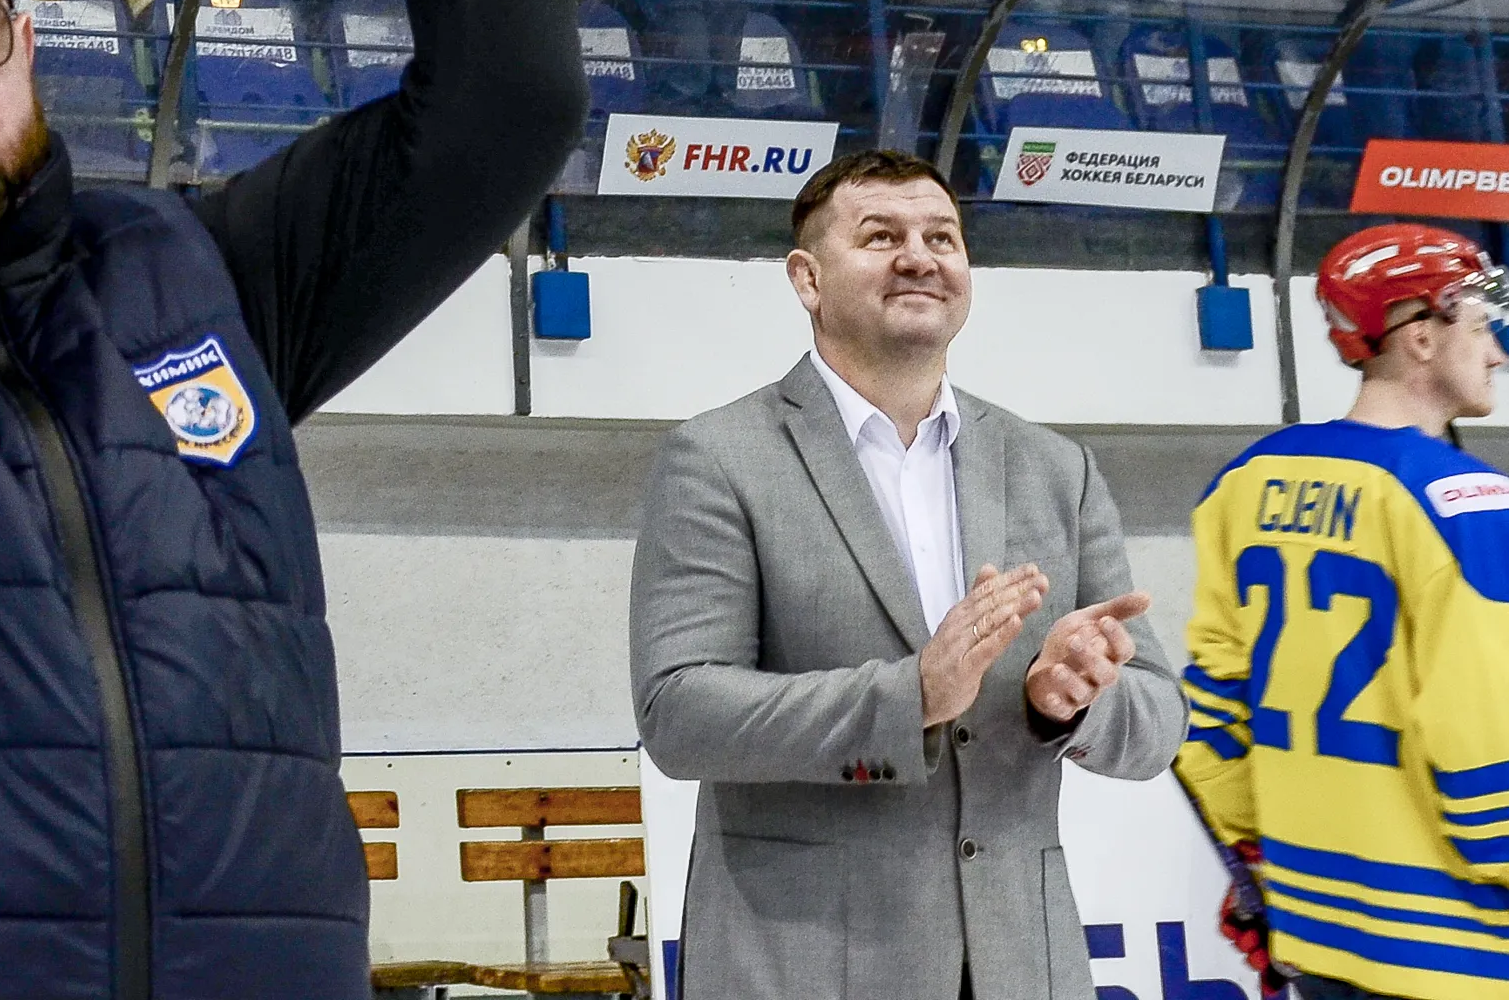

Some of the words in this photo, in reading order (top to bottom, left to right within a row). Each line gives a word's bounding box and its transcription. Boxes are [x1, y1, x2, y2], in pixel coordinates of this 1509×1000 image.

[683, 144, 813, 175] FHR.RU
[1065, 151, 1161, 169] ФЕДЕРАЦИЯ
[1060, 168, 1121, 183] ХОККЕЯ
[1125, 172, 1205, 188] БЕЛАРУСИ
[1235, 544, 1401, 769] 22
